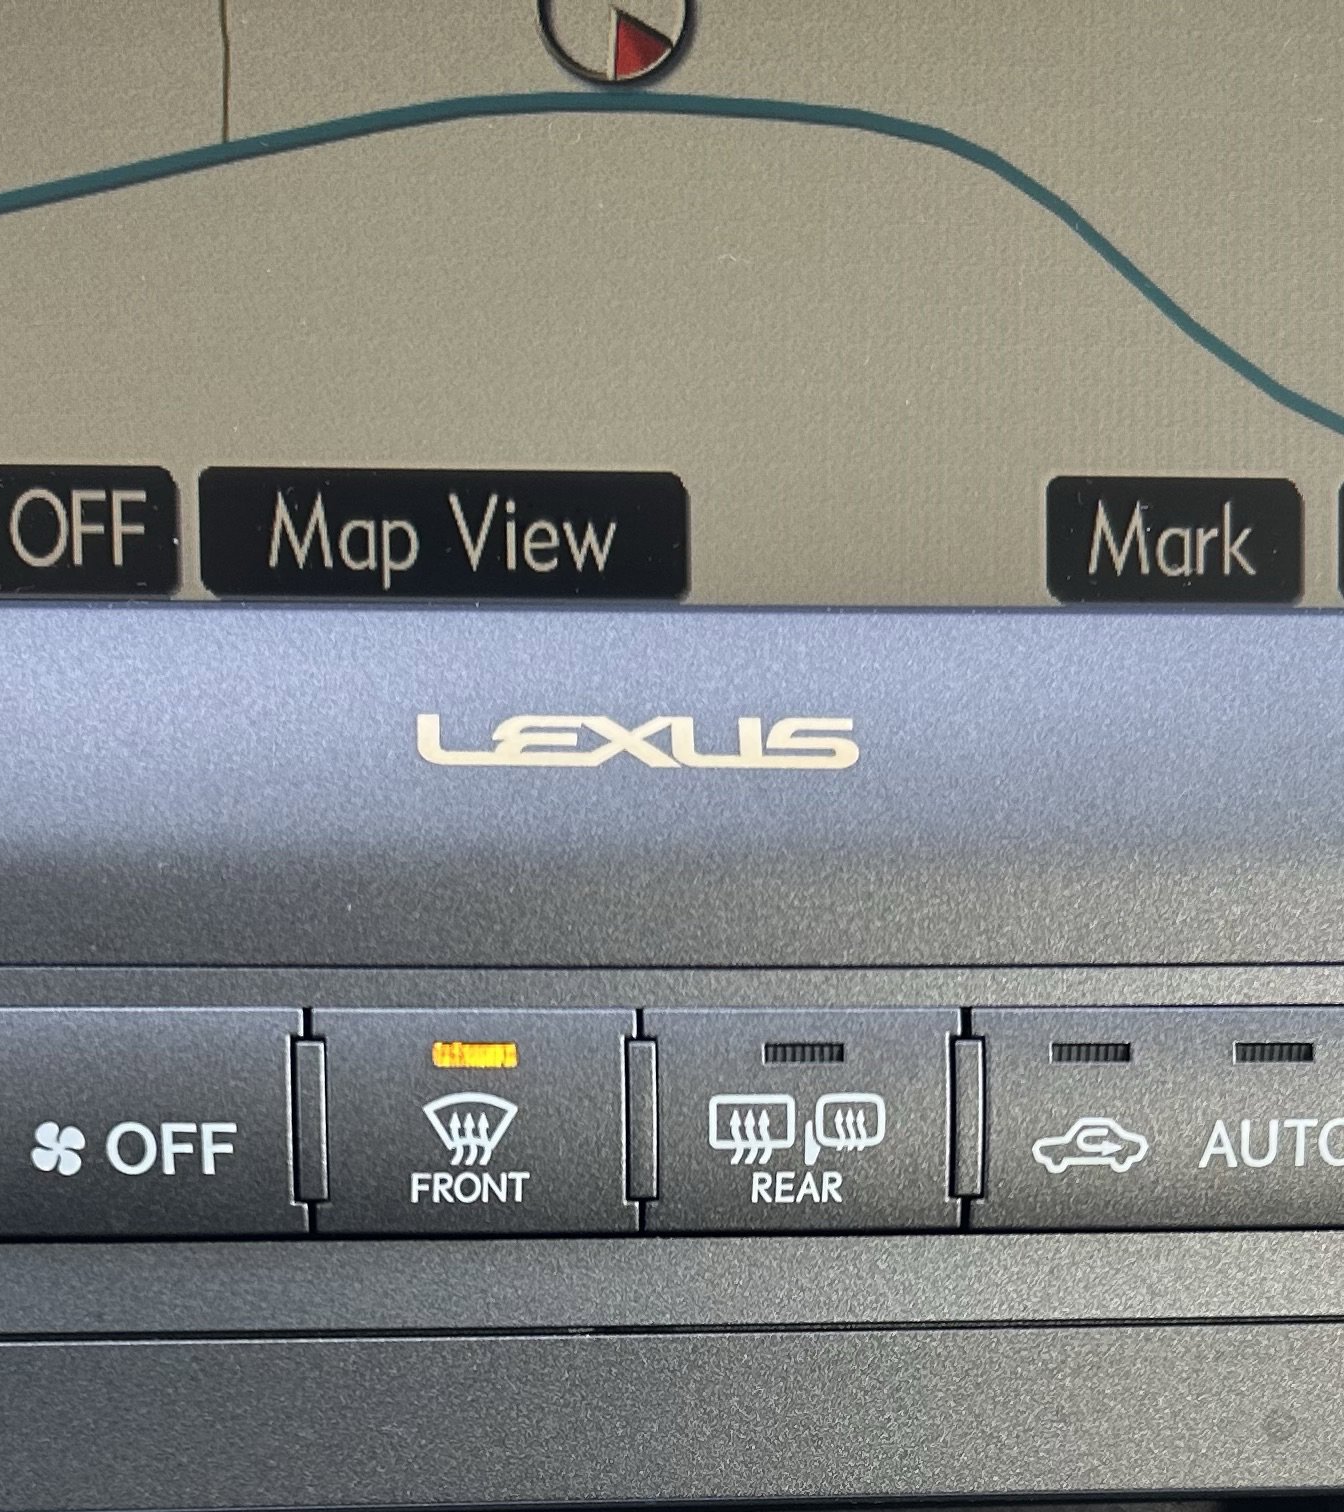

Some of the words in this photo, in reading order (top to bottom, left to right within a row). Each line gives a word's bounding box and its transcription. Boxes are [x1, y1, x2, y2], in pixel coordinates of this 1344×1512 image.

[10, 488, 147, 567] OFF
[269, 491, 419, 589] Map
[449, 493, 617, 572] View
[1088, 500, 1256, 577] Mark
[417, 713, 860, 769] LEXUS
[106, 1121, 237, 1175] OFF
[411, 1171, 530, 1203] FRONT
[751, 1171, 843, 1203] REAR
